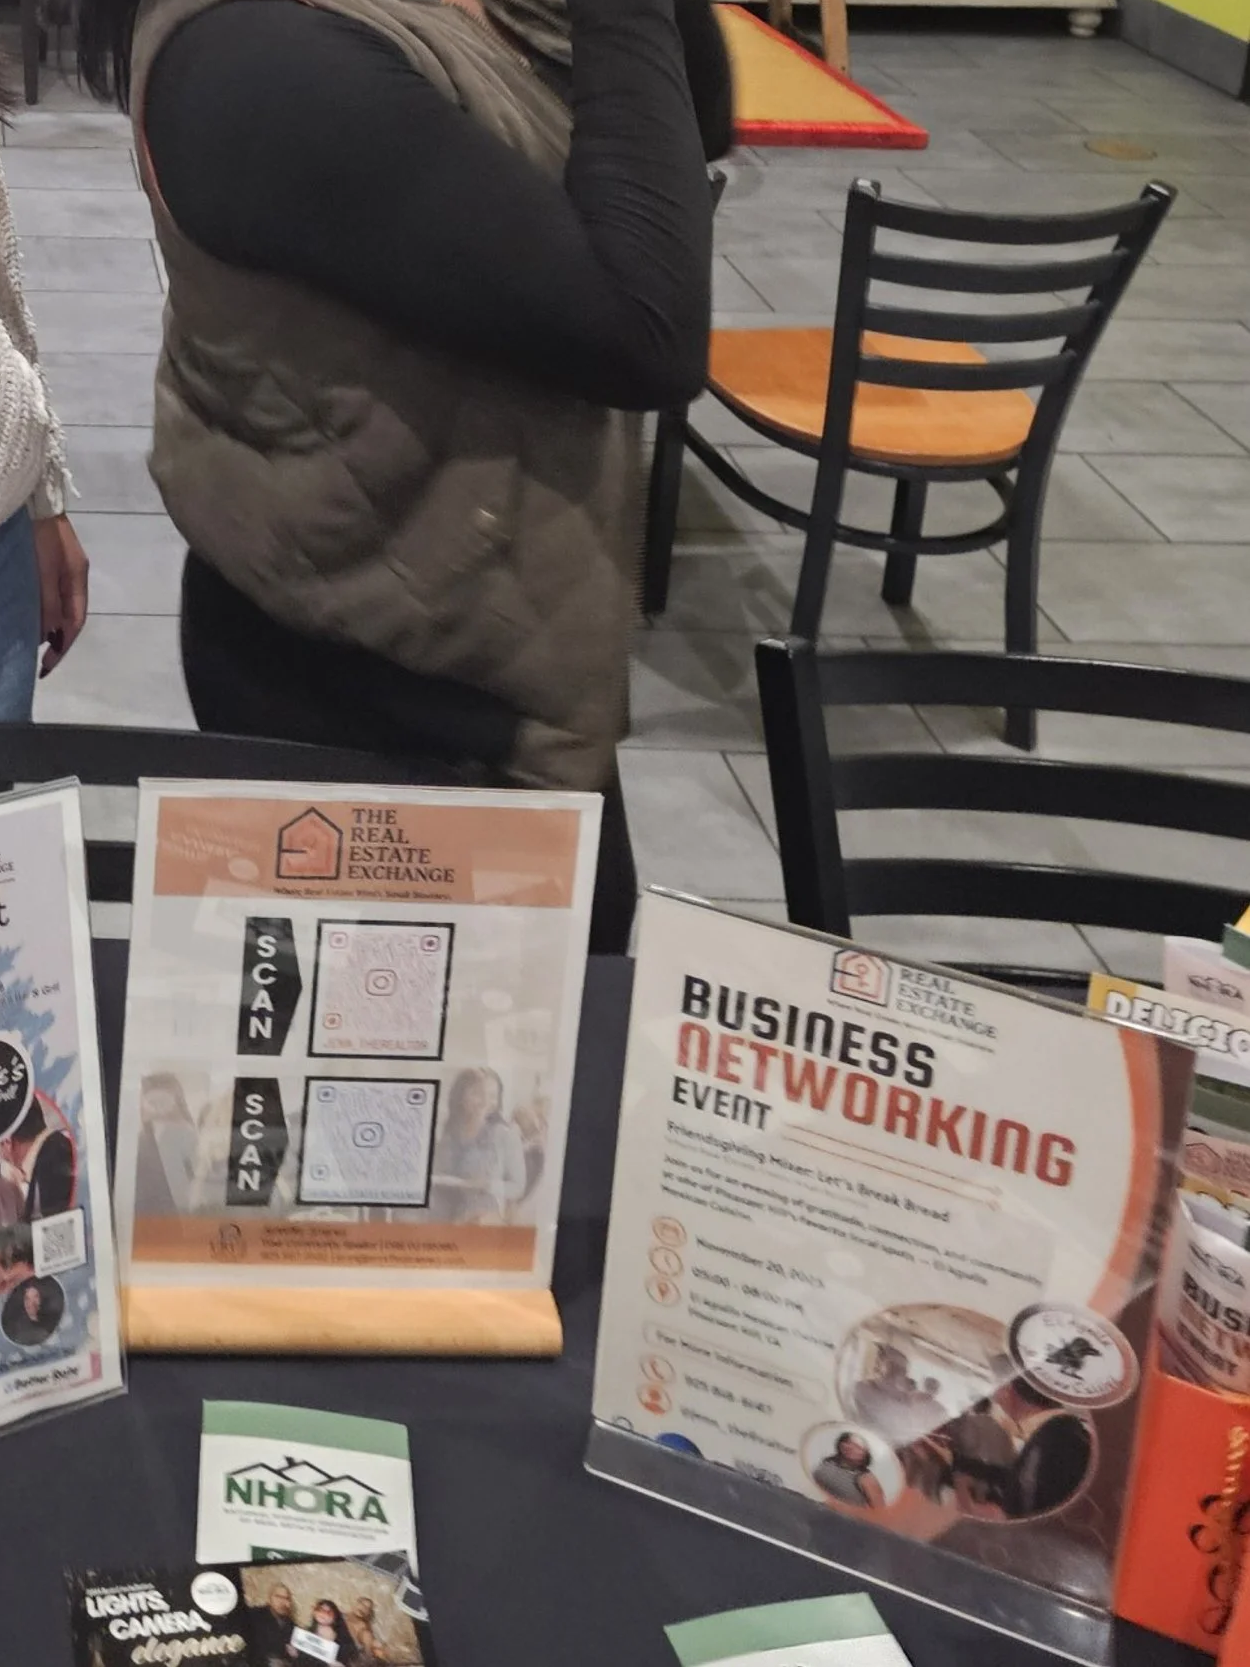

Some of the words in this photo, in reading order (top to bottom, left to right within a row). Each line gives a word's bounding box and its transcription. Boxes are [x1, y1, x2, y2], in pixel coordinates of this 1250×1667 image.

[352, 808, 398, 825] THE
[351, 826, 409, 844] REAL
[350, 845, 431, 864] ESTATE
[348, 865, 455, 883] EXCHANGE
[249, 934, 279, 1040] SCAN
[901, 967, 956, 995] REAL
[896, 997, 998, 1039] EXCHANGE
[898, 985, 976, 1016] ESTATE
[682, 974, 936, 1089] BUSINESS
[672, 1074, 773, 1131] EVENT
[676, 1020, 1077, 1188] NETWORKING
[237, 1093, 266, 1192] SCAN
[224, 1473, 390, 1526] NHORA
[85, 1590, 171, 1619] LIGHTS,
